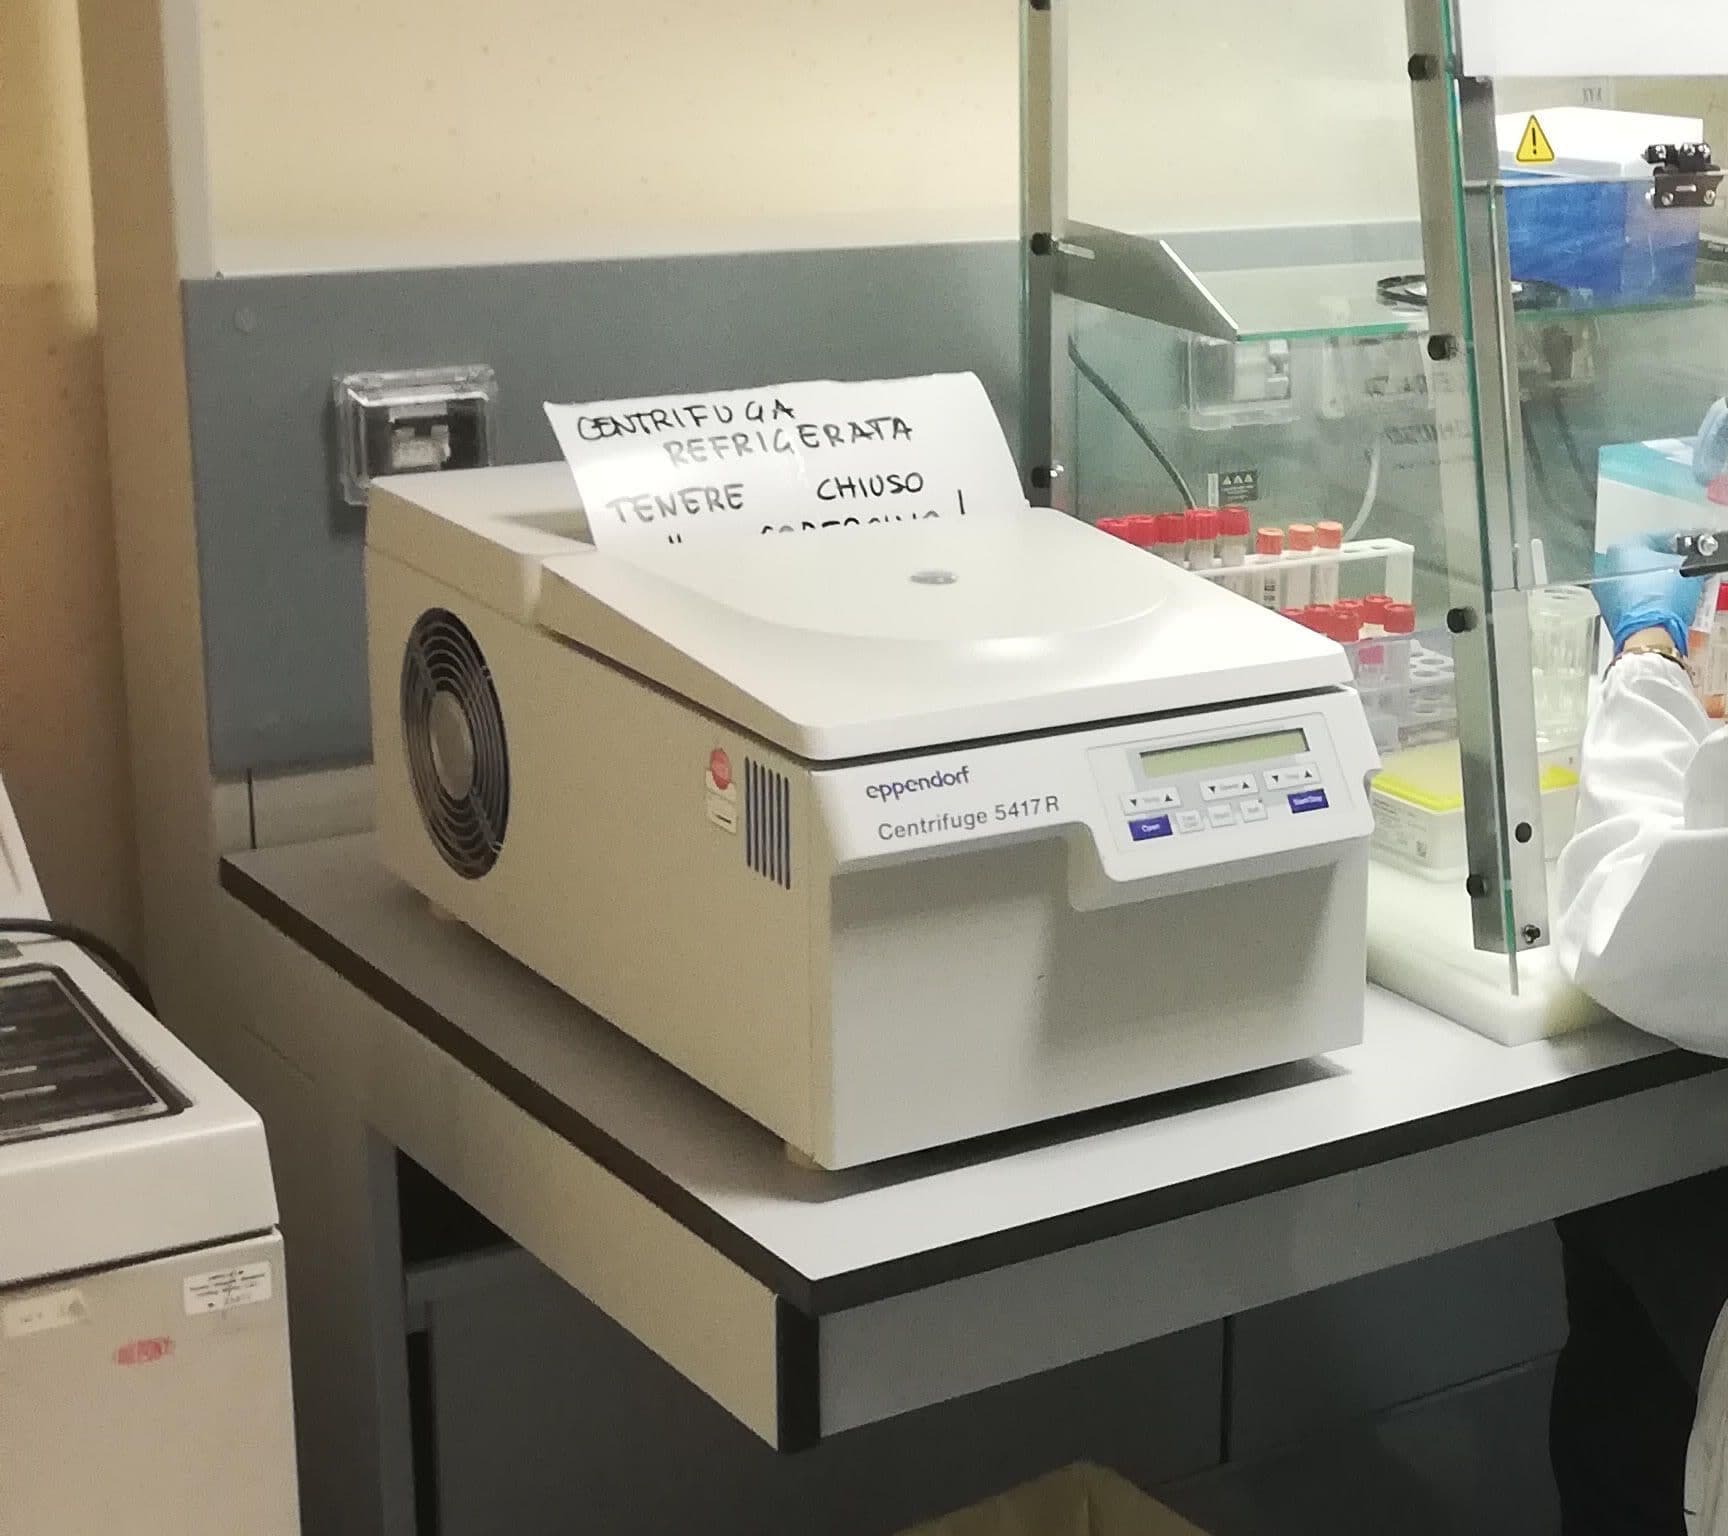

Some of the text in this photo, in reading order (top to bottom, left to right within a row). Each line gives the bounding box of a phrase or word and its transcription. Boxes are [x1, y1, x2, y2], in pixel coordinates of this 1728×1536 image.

[577, 398, 797, 441] CENTRIFUGA
[662, 416, 914, 468] REFRIGERATA
[605, 483, 745, 525] TENERE
[816, 471, 924, 502] CHIUSO
[865, 765, 970, 803] eppendorf
[877, 795, 1061, 841] Centrifuge 5417 R
